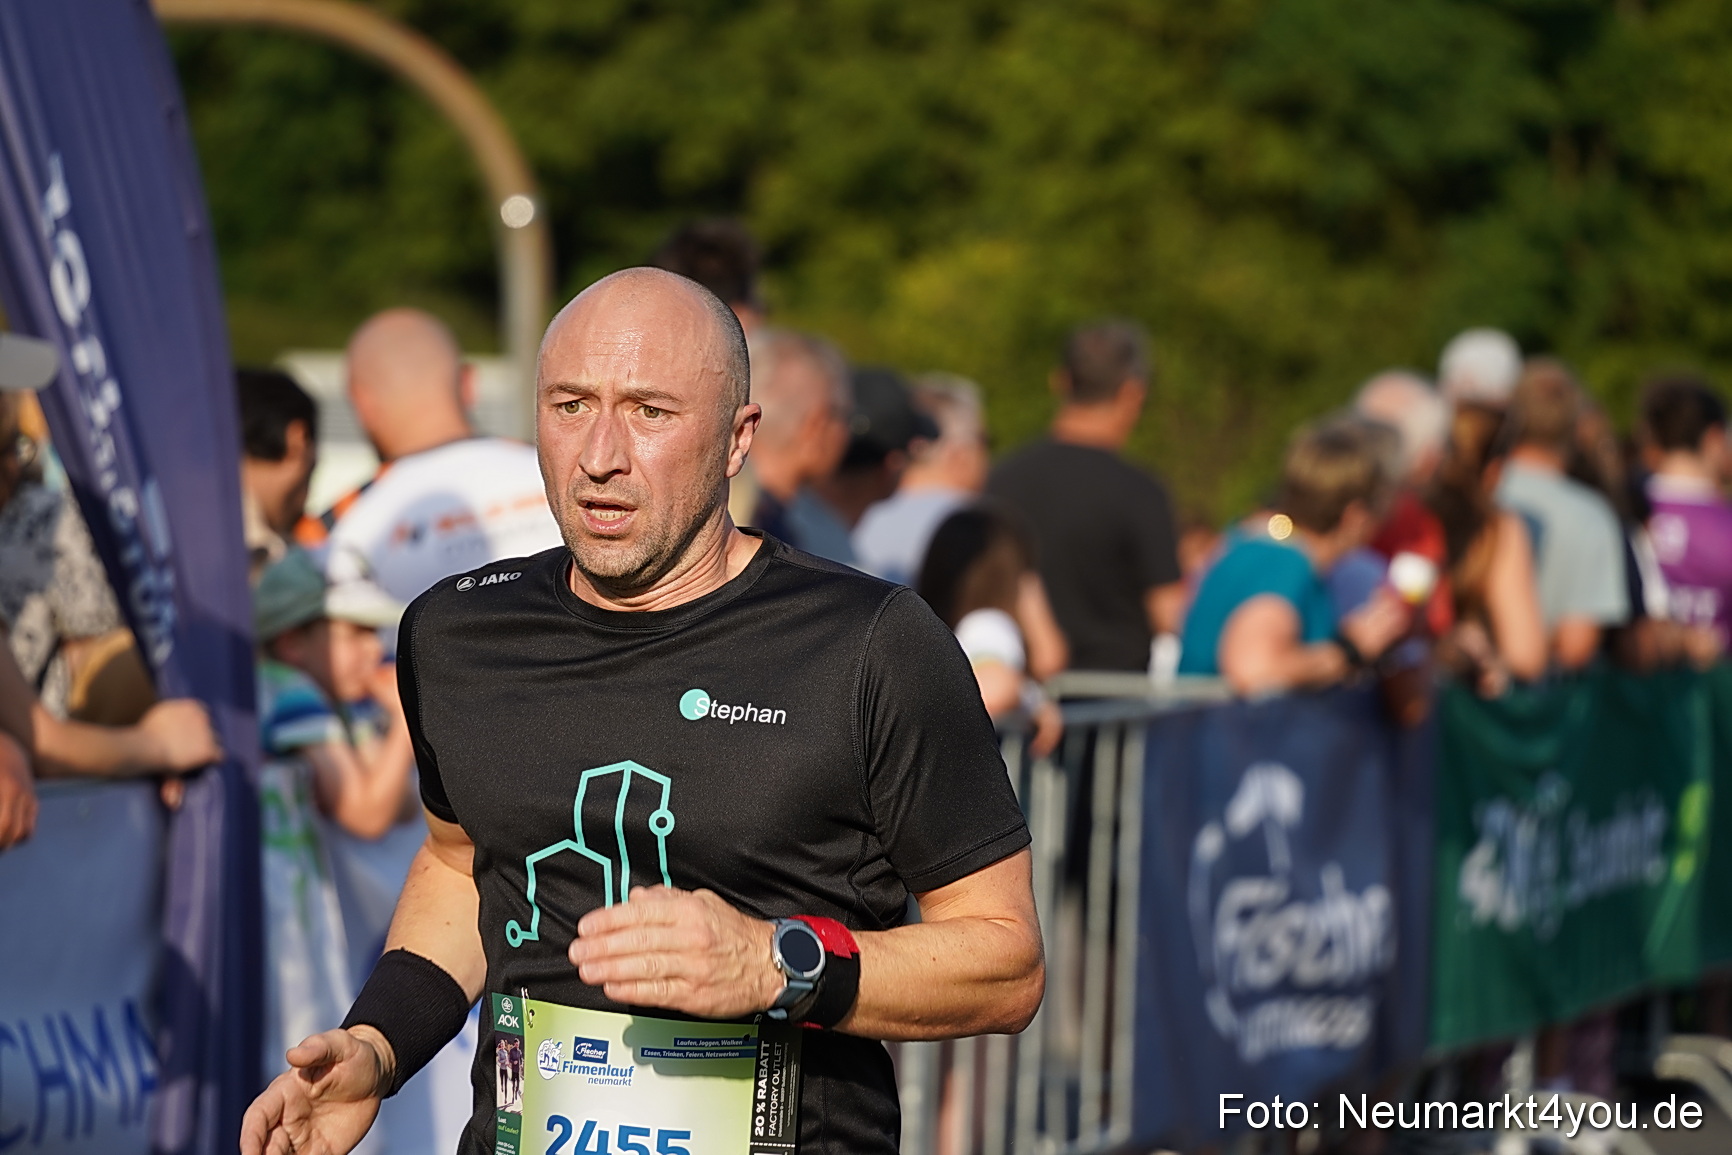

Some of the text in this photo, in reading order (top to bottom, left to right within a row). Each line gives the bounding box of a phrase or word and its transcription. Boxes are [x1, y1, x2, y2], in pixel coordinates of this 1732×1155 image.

[478, 571, 522, 587] JAKO
[693, 697, 787, 725] Stephan
[497, 1013, 520, 1029] AOK
[676, 1039, 698, 1047] Laufen,
[580, 1046, 607, 1058] Fischer
[562, 1060, 635, 1078] Firmenlauf
[587, 1077, 632, 1087] neumarkt
[754, 1040, 770, 1137] 20 % RABATT
[768, 1042, 782, 1137] FACTORY OUTLET
[545, 1114, 691, 1155] 2455
